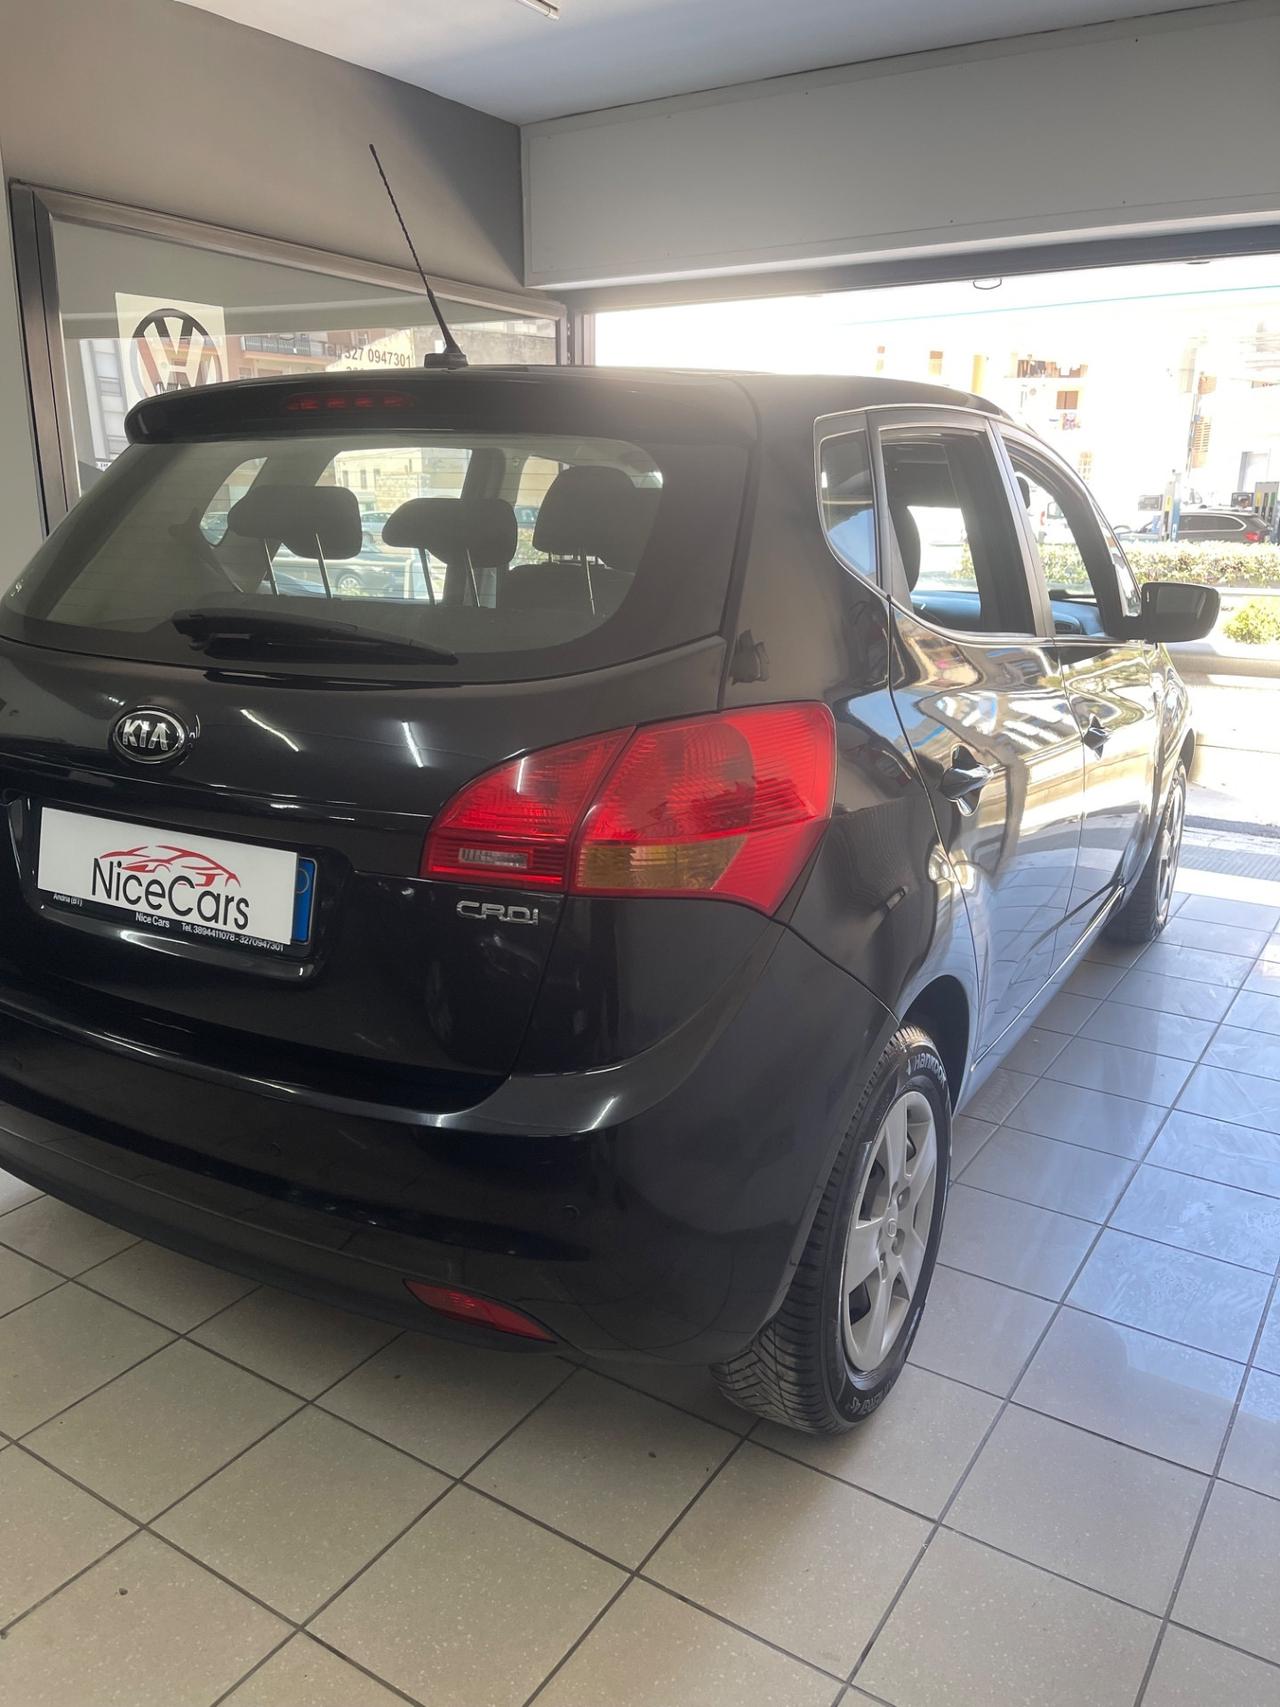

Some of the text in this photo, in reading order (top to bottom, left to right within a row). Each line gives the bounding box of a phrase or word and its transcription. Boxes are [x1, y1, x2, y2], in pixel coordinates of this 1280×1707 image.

[367, 348, 411, 368] 0947301
[122, 719, 170, 751] KIA
[91, 857, 250, 931] NiceCars
[135, 911, 152, 924] Nice
[152, 915, 171, 928] Cars
[193, 925, 235, 941] 3894411078
[239, 935, 285, 952] 3270947301
